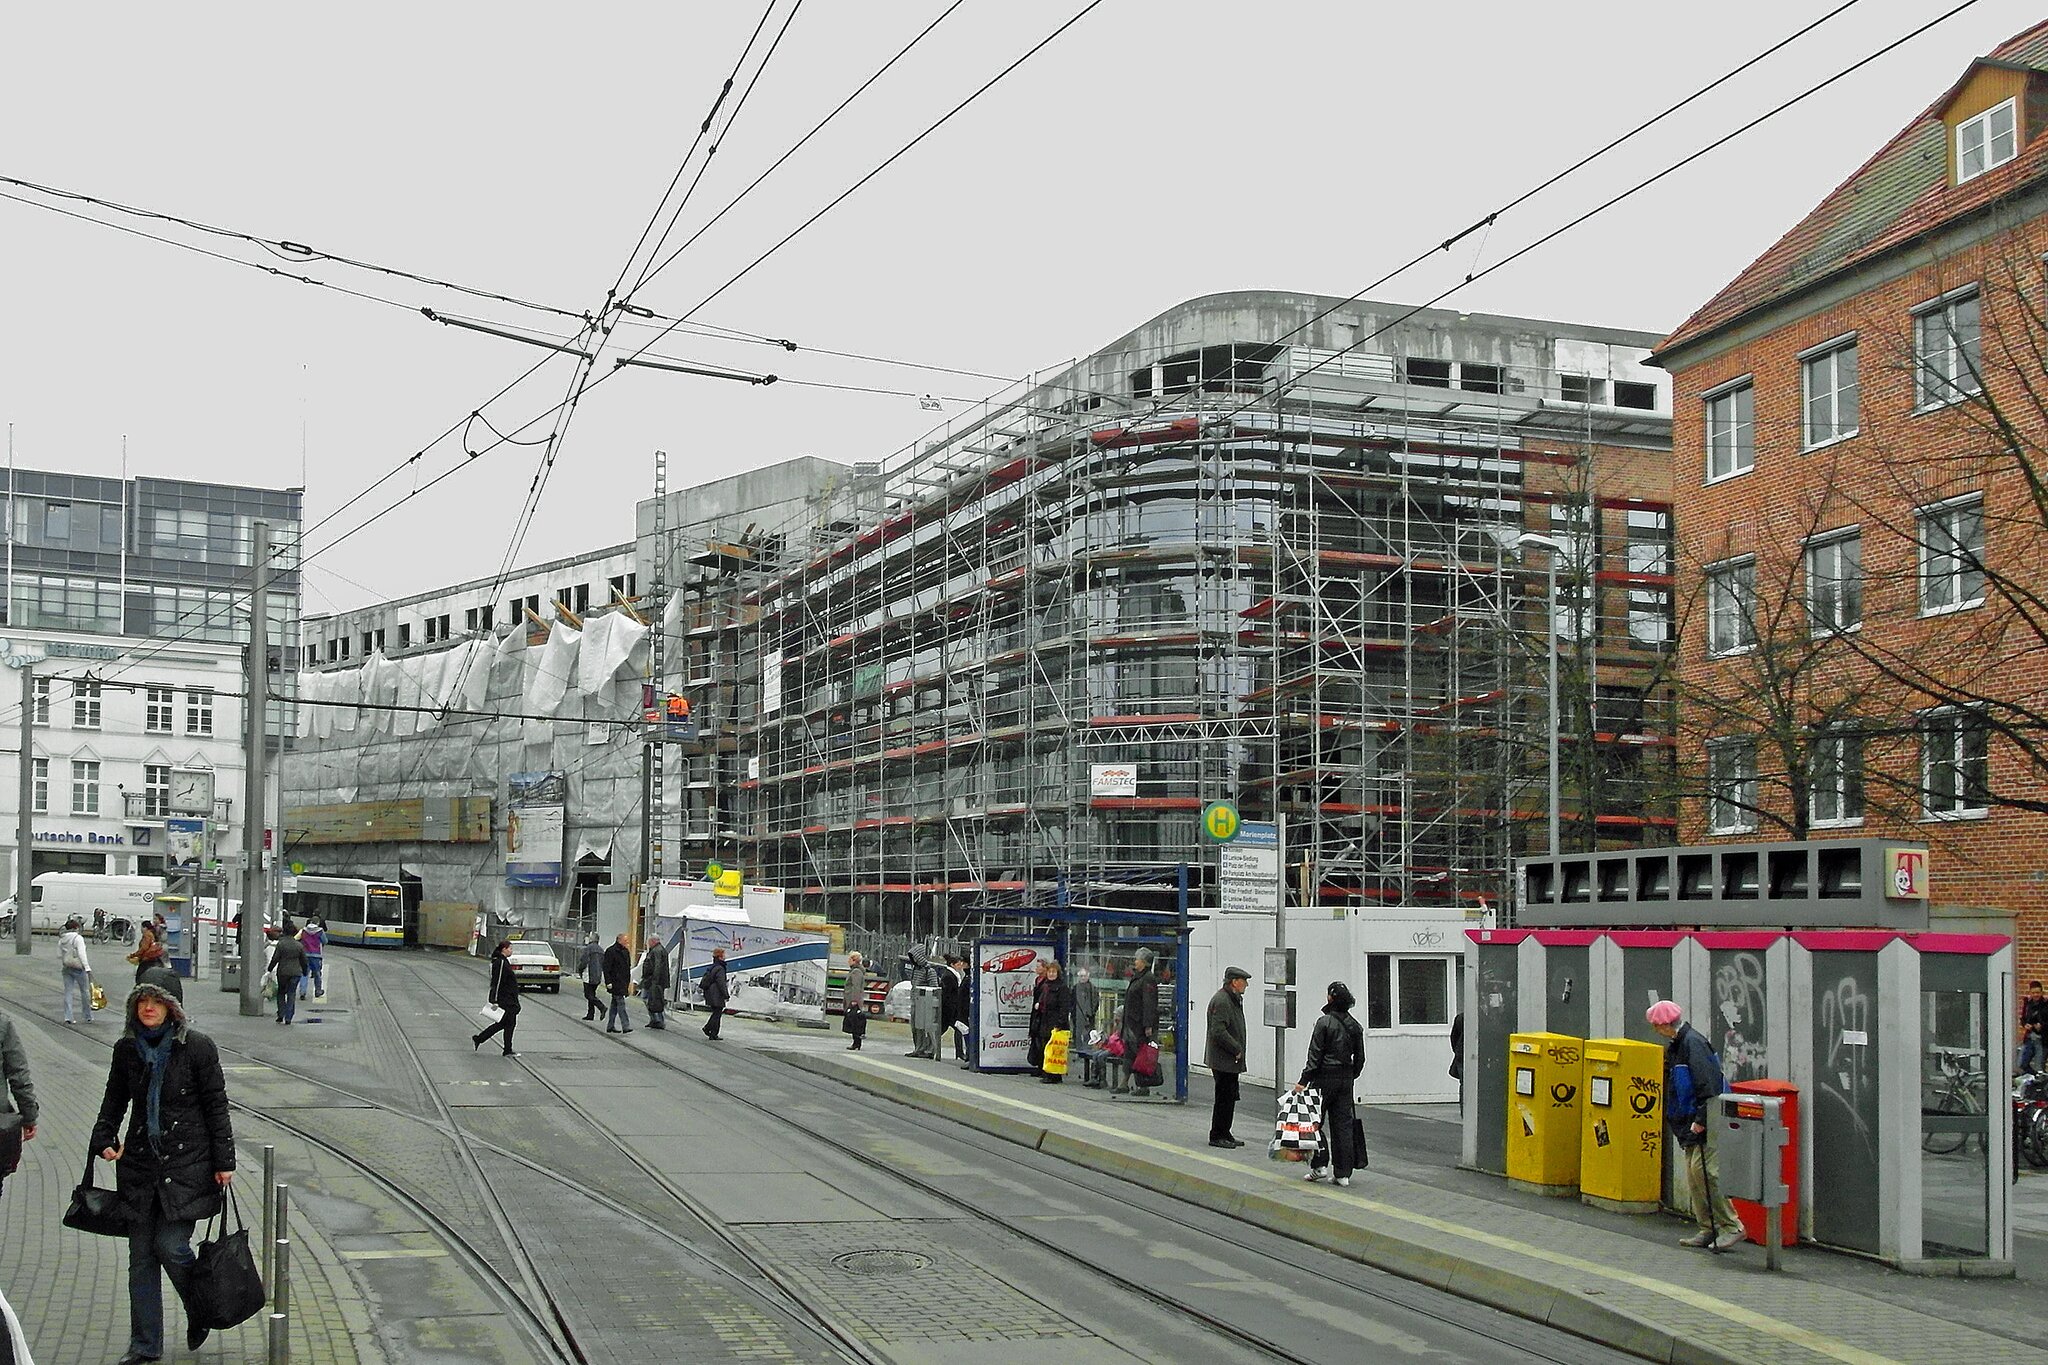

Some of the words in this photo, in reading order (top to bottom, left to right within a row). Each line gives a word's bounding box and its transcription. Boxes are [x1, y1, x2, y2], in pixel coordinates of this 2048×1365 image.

[1214, 810, 1230, 833] H
[16, 829, 82, 842] utsche
[88, 832, 124, 845] Bank
[1240, 831, 1276, 839] Marienplatz
[1898, 853, 1922, 894] T
